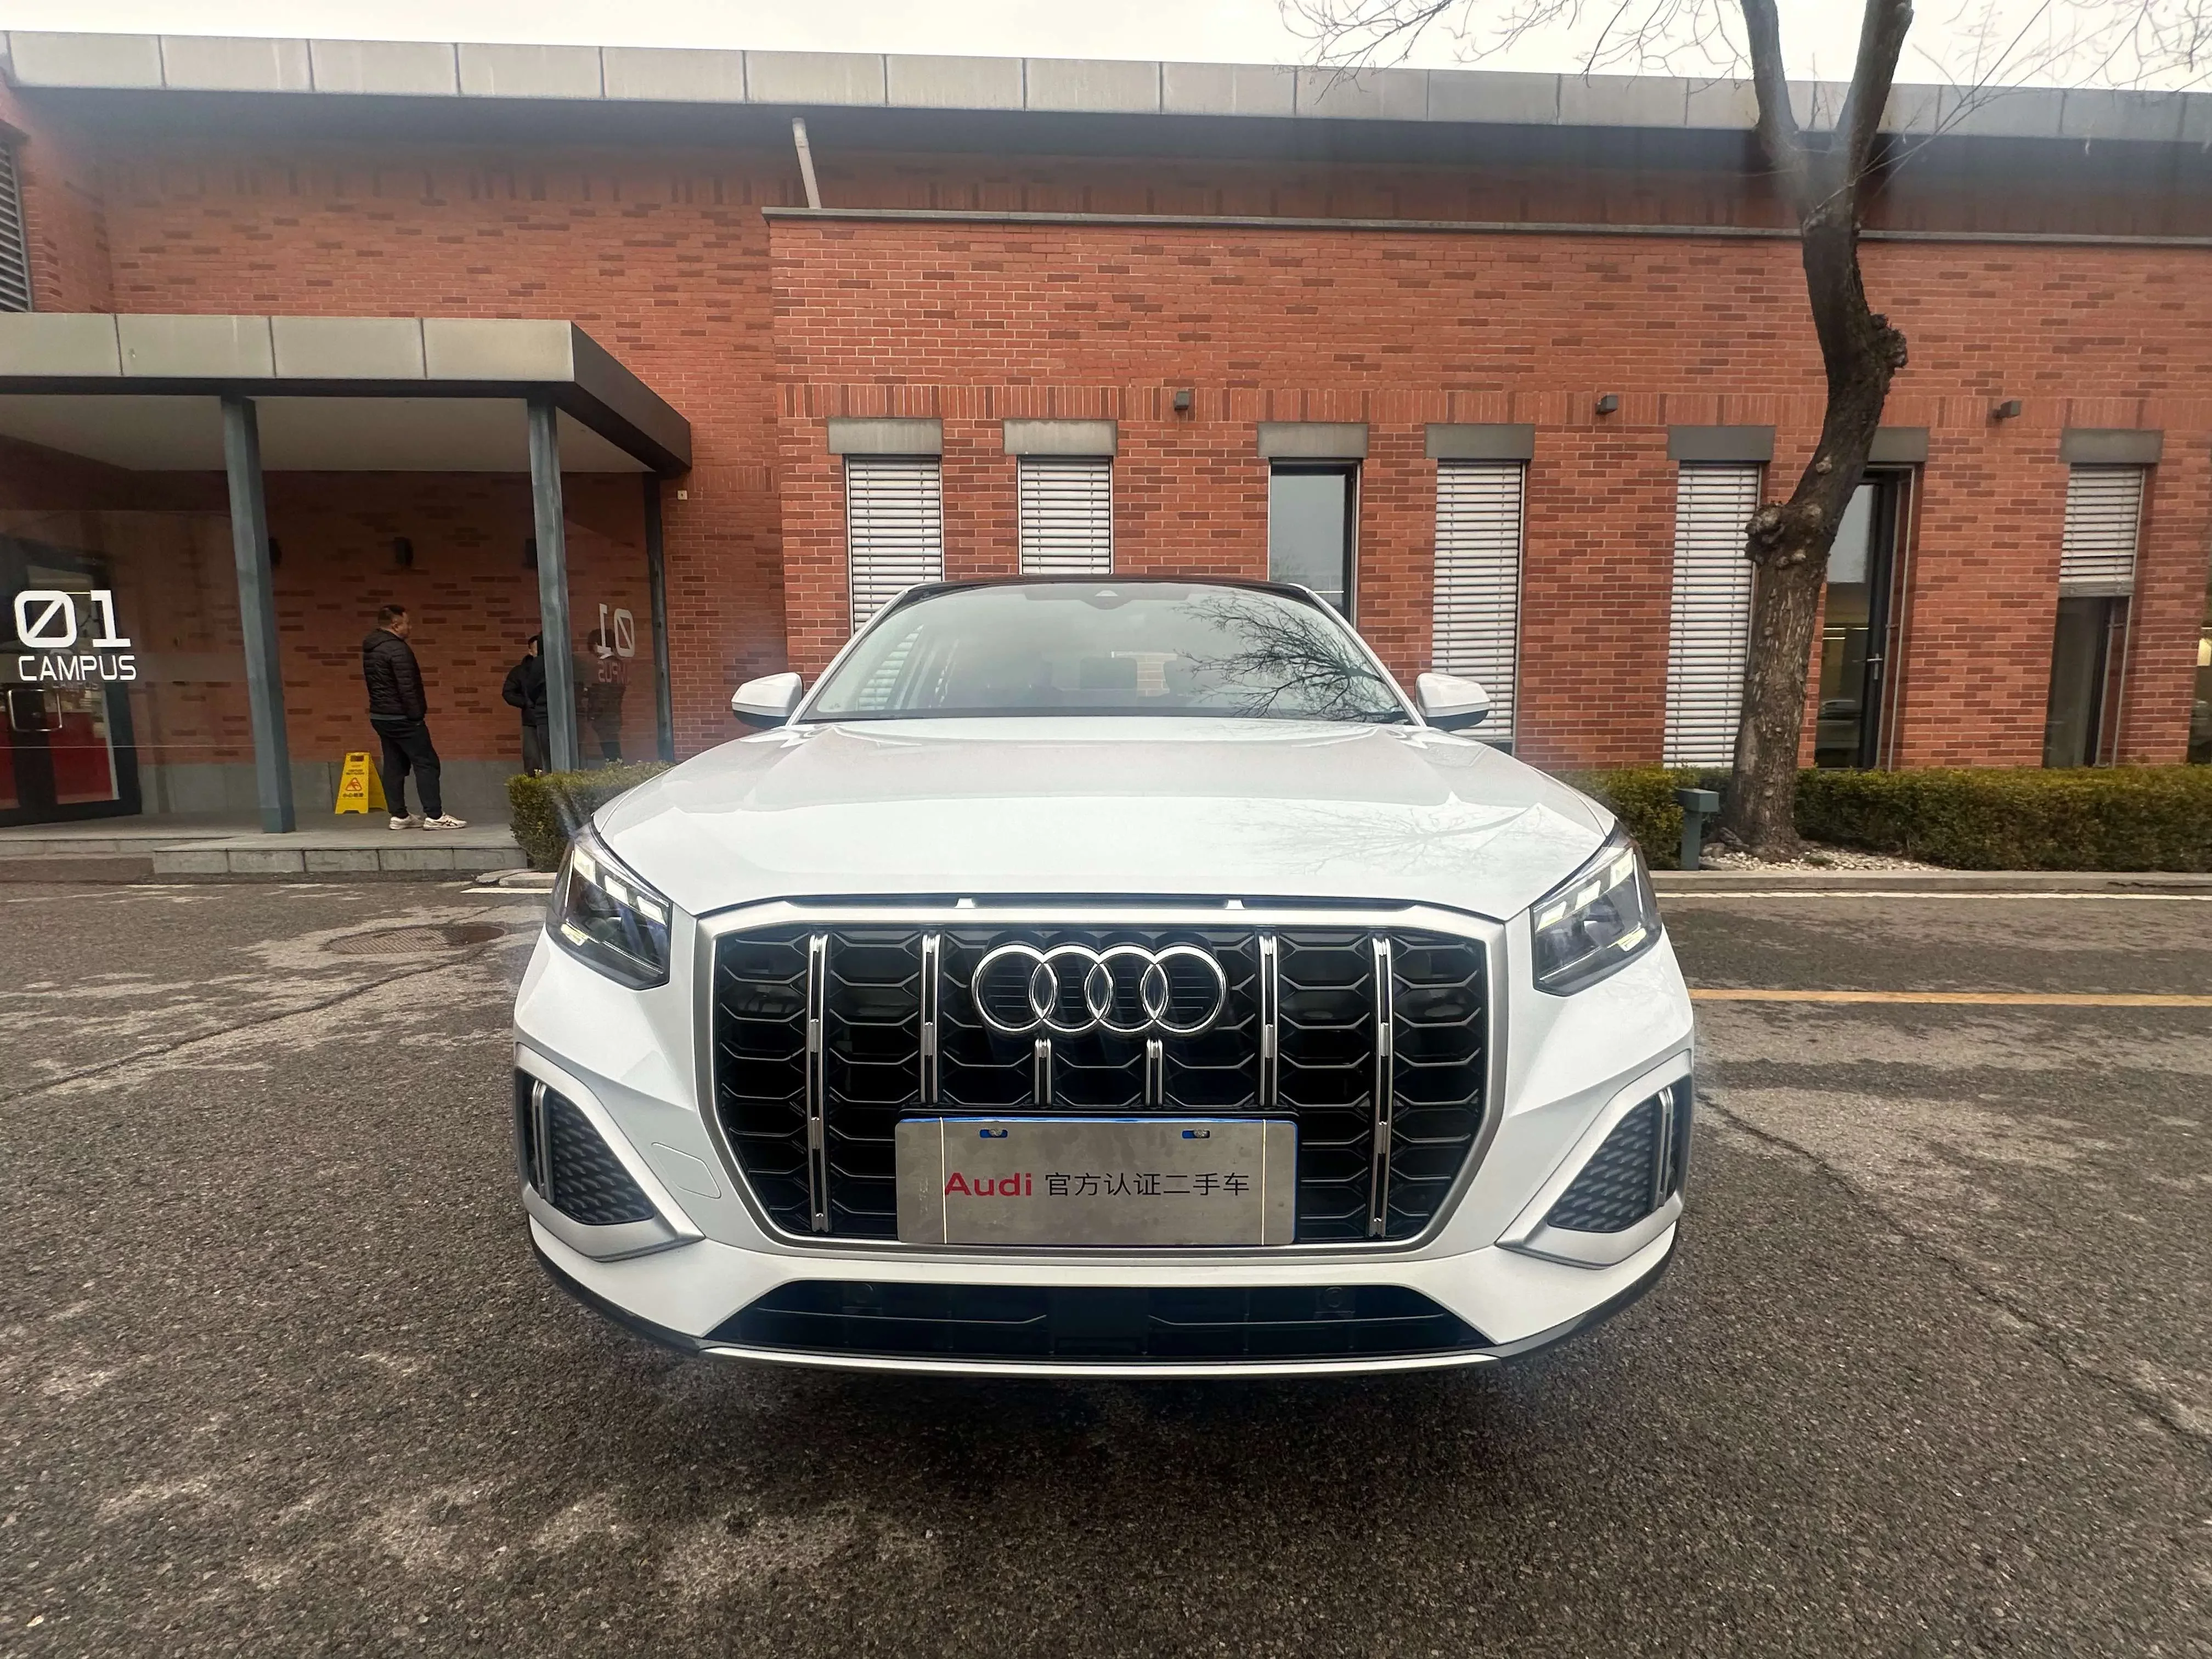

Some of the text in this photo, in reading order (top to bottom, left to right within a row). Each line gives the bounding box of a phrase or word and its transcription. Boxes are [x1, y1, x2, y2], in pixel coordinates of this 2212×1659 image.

[14, 590, 131, 648] 01
[18, 655, 137, 681] CAMPUS
[944, 1172, 1250, 1197] Audi 官方认证二手车
